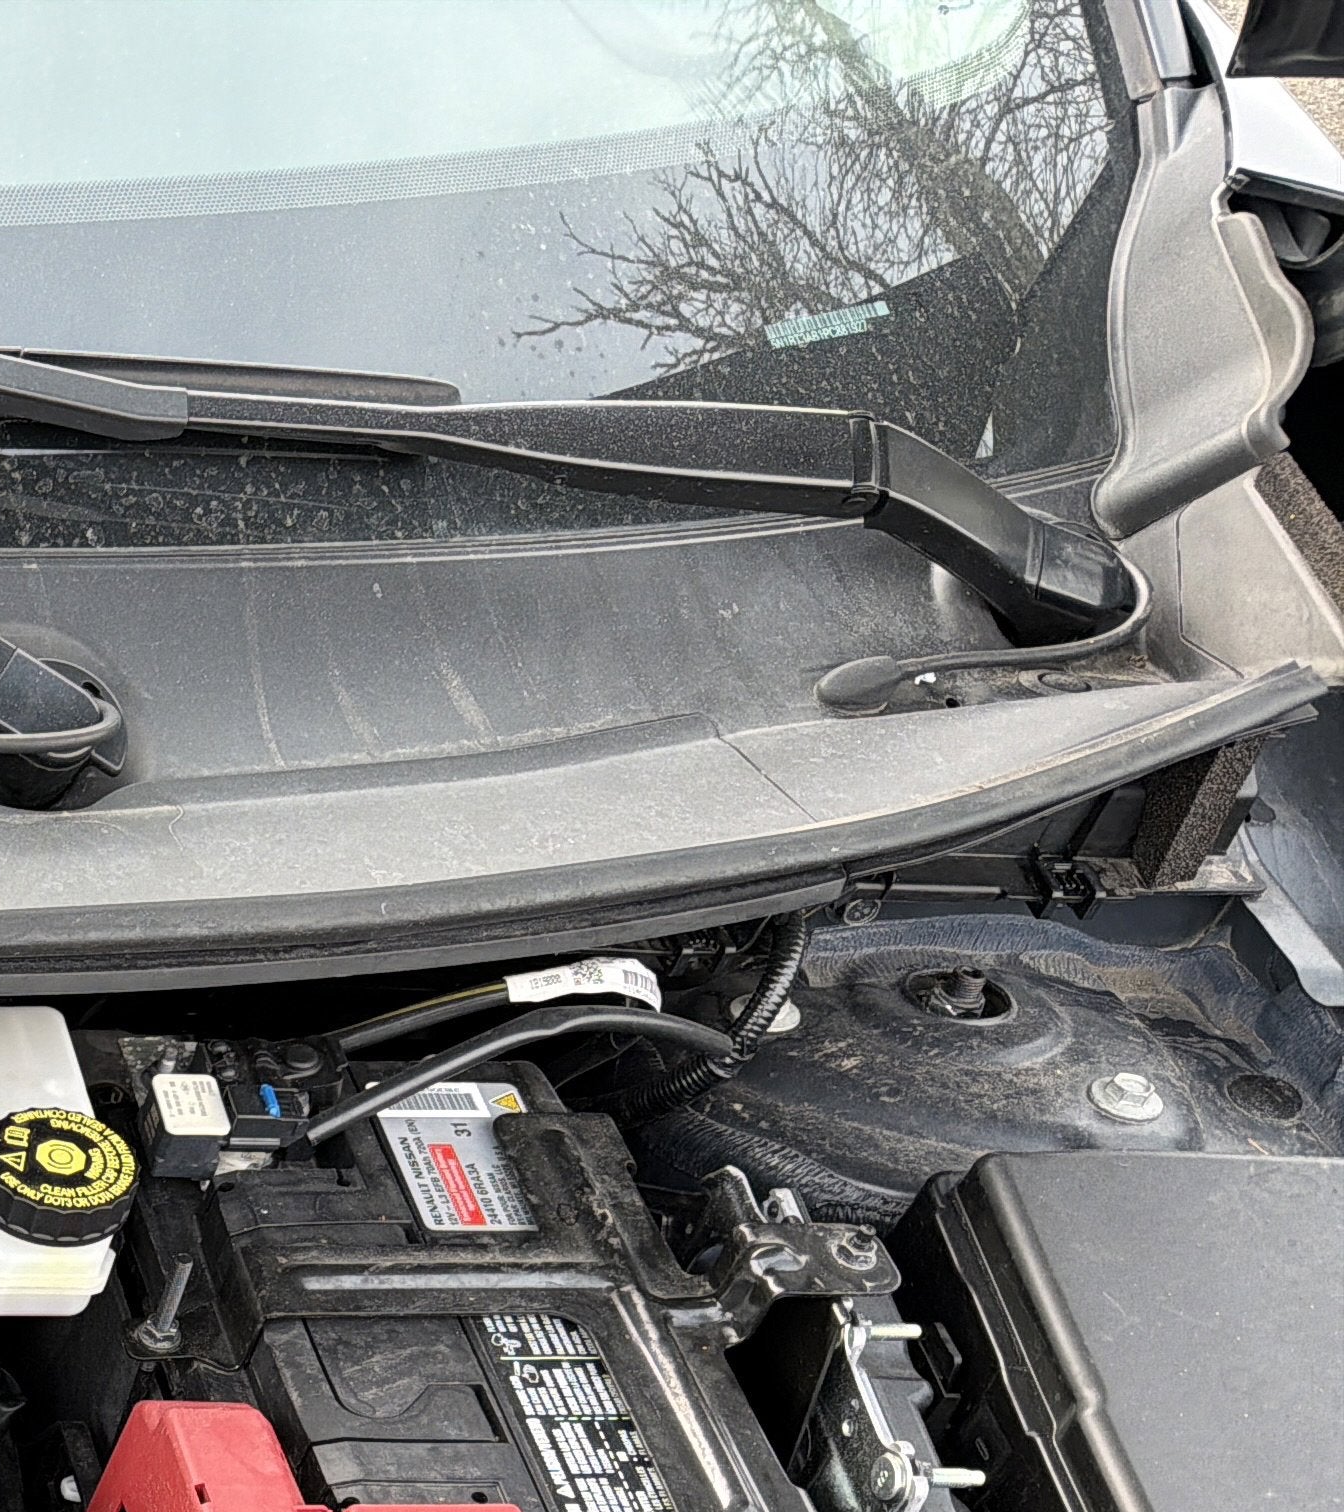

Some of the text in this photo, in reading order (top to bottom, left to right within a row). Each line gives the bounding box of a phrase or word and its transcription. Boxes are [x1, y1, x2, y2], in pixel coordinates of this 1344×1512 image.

[450, 1122, 472, 1137] 31
[398, 1136, 445, 1225] RENAULT NISSAN
[40, 1183, 76, 1198] CLEAN
